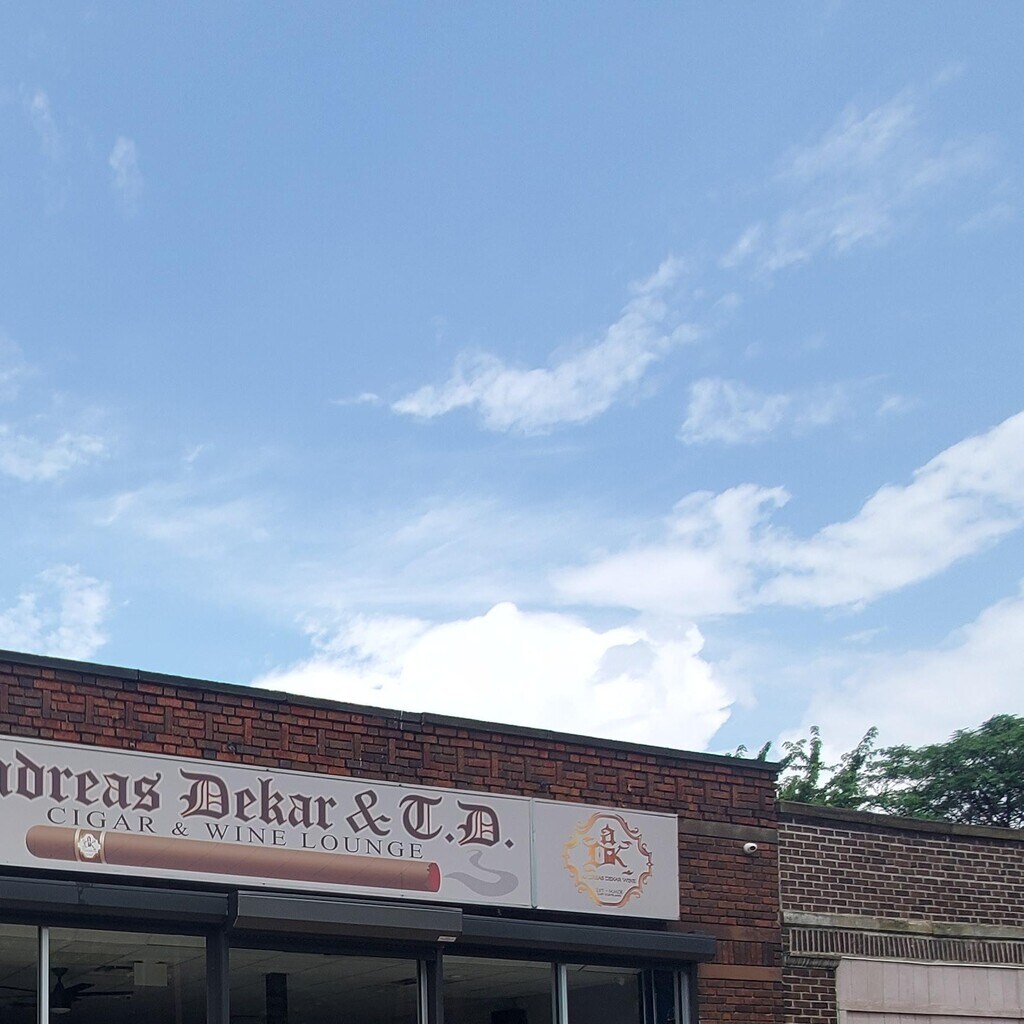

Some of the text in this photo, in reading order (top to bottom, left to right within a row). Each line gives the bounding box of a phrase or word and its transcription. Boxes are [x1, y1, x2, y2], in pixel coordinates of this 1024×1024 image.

[47, 806, 424, 860] CIGAR & WINE LOUNGE
[178, 767, 338, 832] Dekar
[345, 788, 392, 838] &
